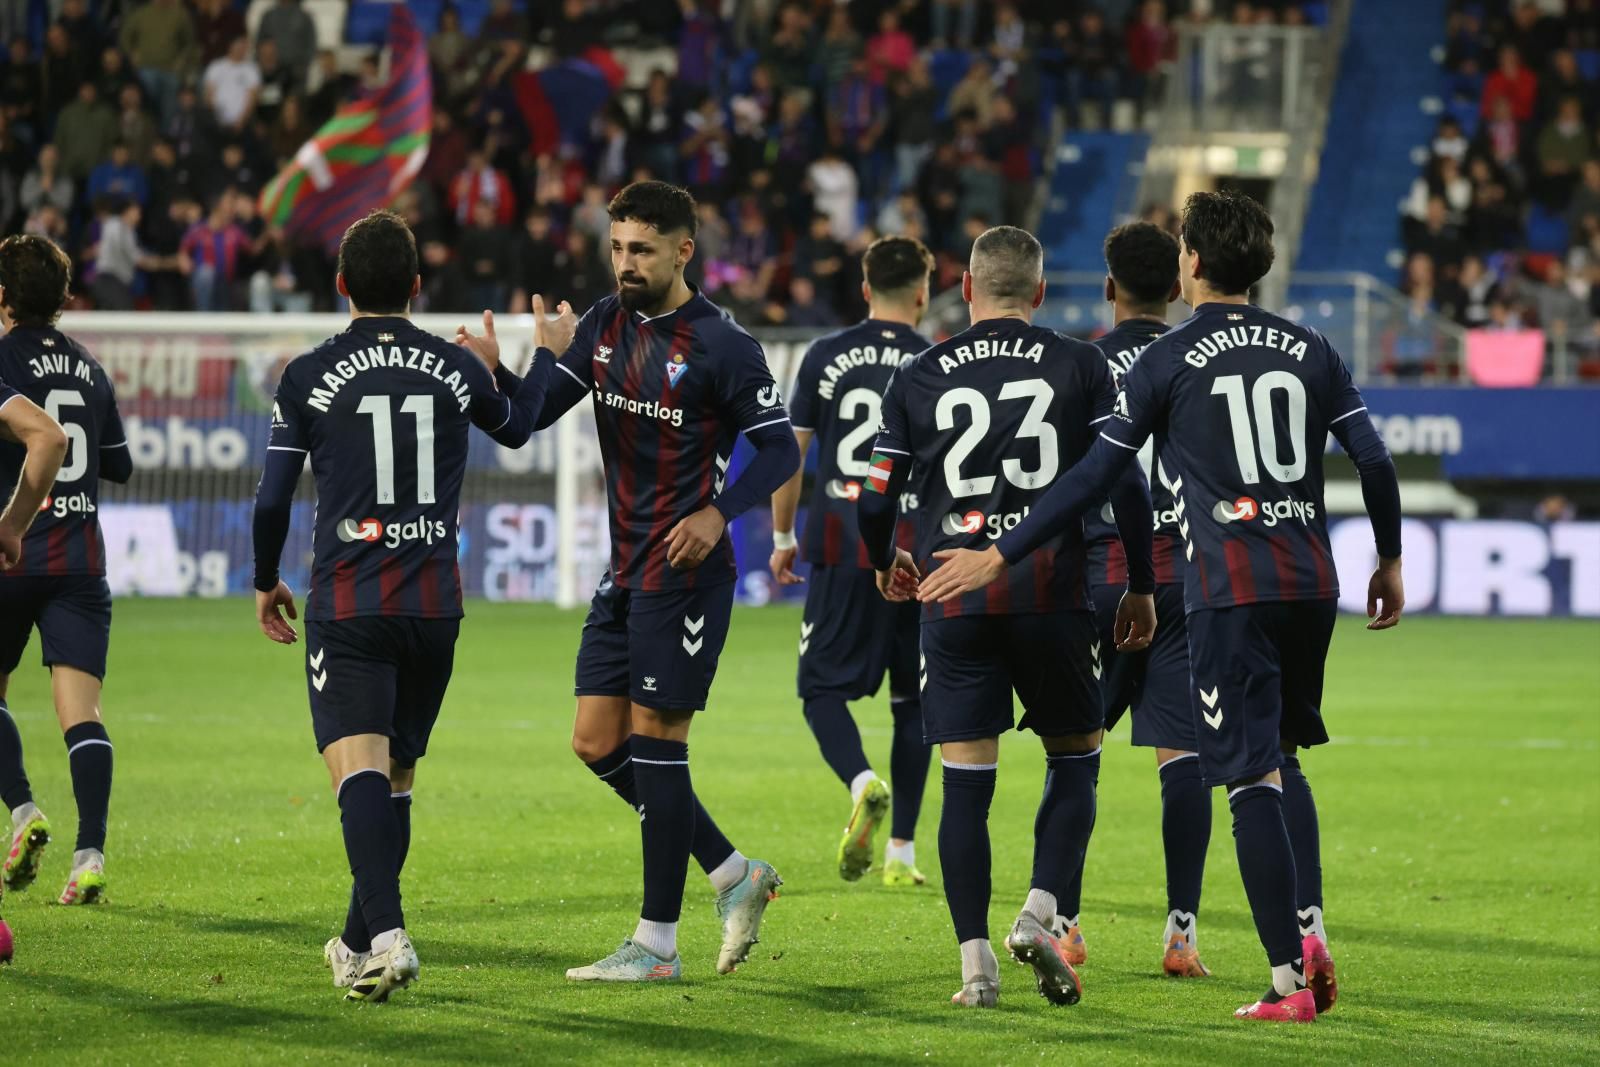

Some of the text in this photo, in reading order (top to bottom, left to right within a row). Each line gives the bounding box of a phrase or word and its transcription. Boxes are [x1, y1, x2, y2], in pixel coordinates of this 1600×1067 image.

[29, 354, 94, 386] JAVI M.
[938, 338, 1045, 375] ARBILLA
[1185, 325, 1309, 368] GURUZETA
[307, 346, 471, 413] MAGUNAZELAIA
[818, 346, 877, 400] MARCO
[605, 393, 683, 427] smartlog
[1210, 370, 1307, 485] 10
[44, 388, 88, 482] 6
[356, 395, 436, 504] 11
[935, 378, 1059, 498] 23
[385, 515, 446, 548] galys
[1261, 495, 1315, 527] galys
